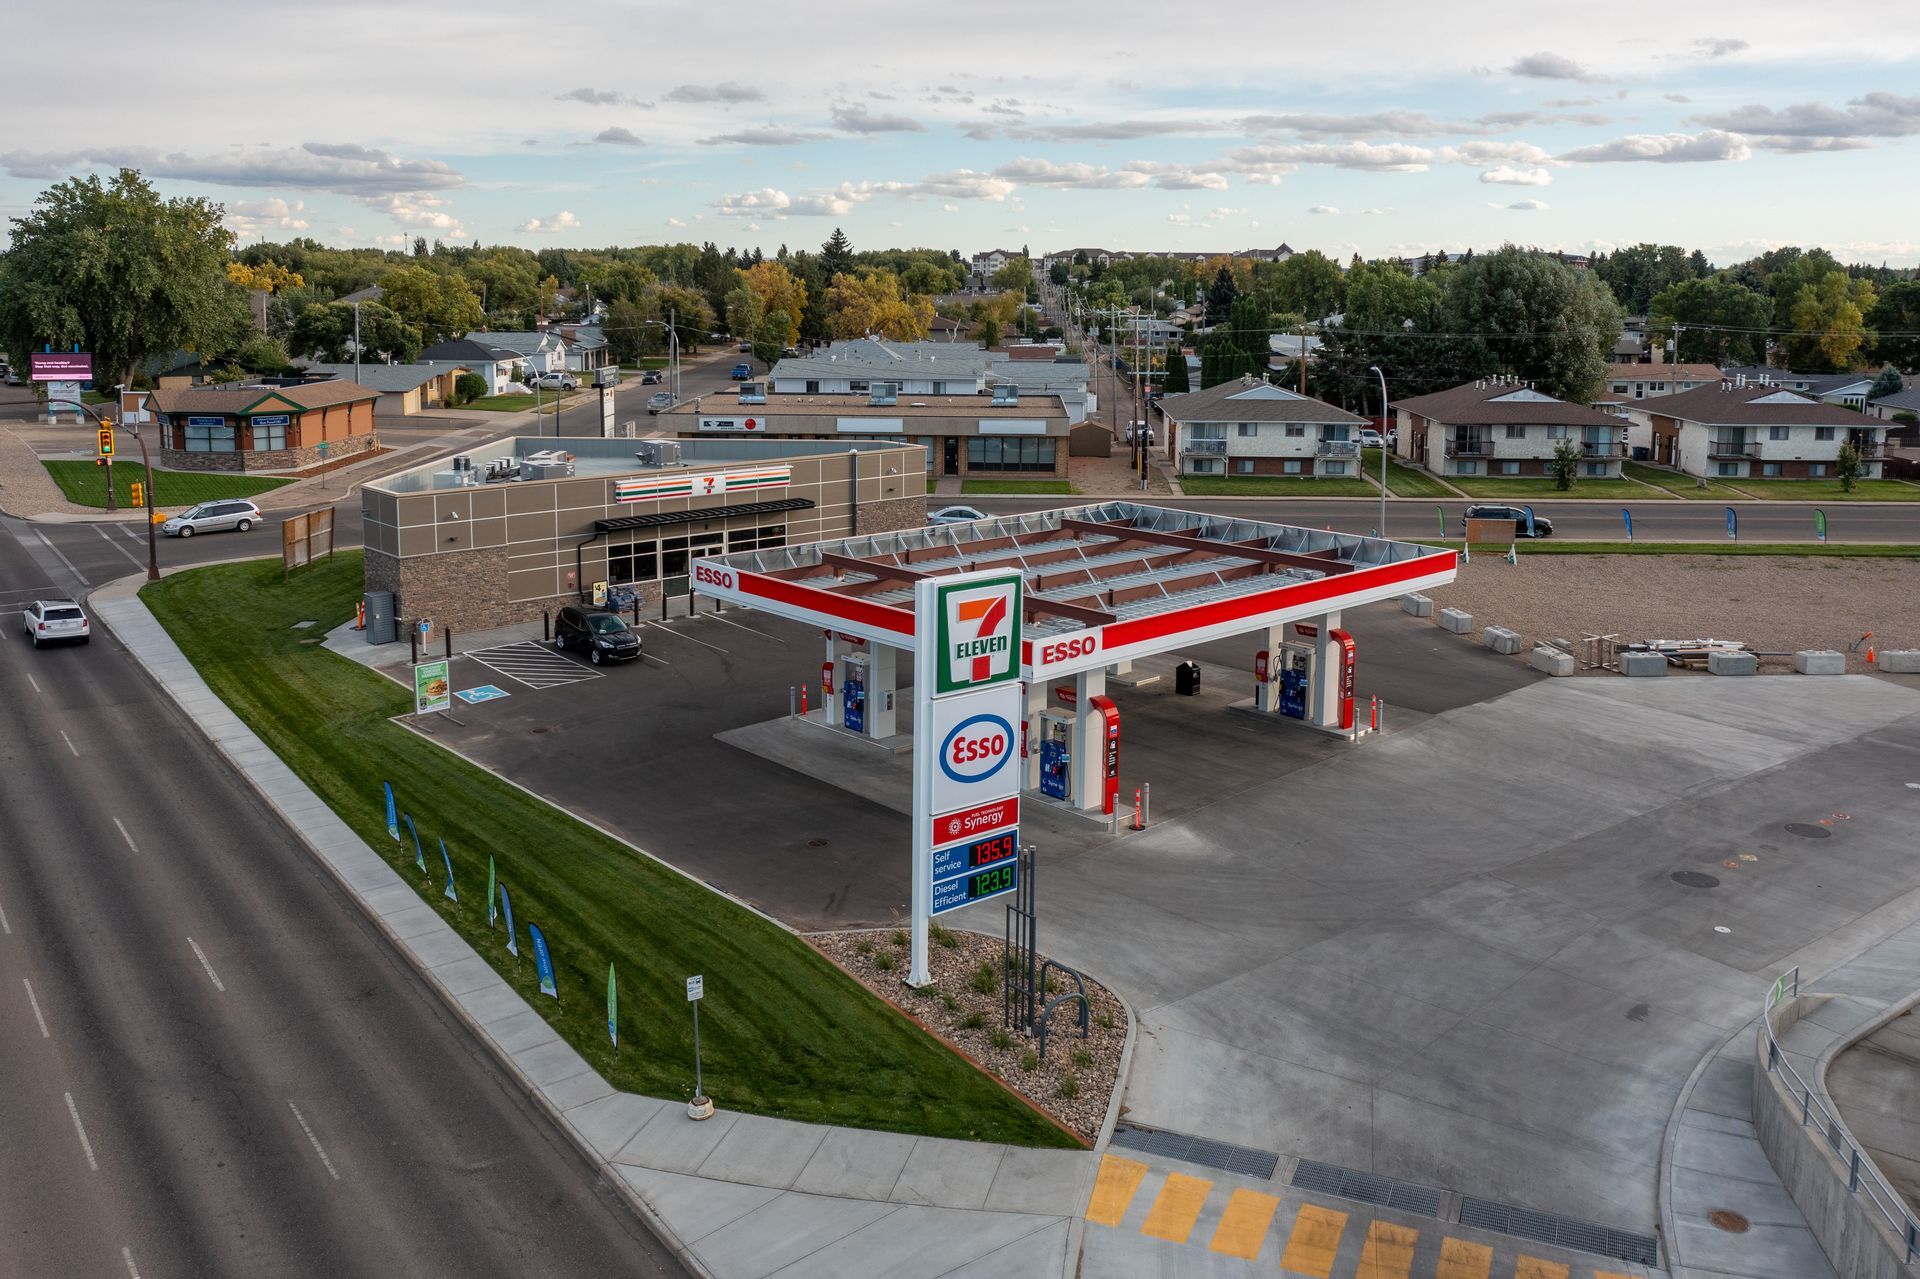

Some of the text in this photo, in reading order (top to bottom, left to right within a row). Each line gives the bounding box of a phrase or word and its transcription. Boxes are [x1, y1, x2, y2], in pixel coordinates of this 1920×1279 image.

[703, 477, 715, 494] 7
[696, 565, 733, 589] ESSO
[958, 594, 1007, 682] 7
[1042, 636, 1097, 665] ESSO
[980, 805, 1004, 815] TECHNOLOGY
[964, 810, 1004, 830] Synergy
[934, 850, 951, 864] Self
[975, 836, 1013, 865] 135.9
[934, 859, 962, 875] service
[934, 880, 959, 896] Diesel
[975, 867, 1012, 896] 123.9
[934, 891, 967, 909] Efficient
